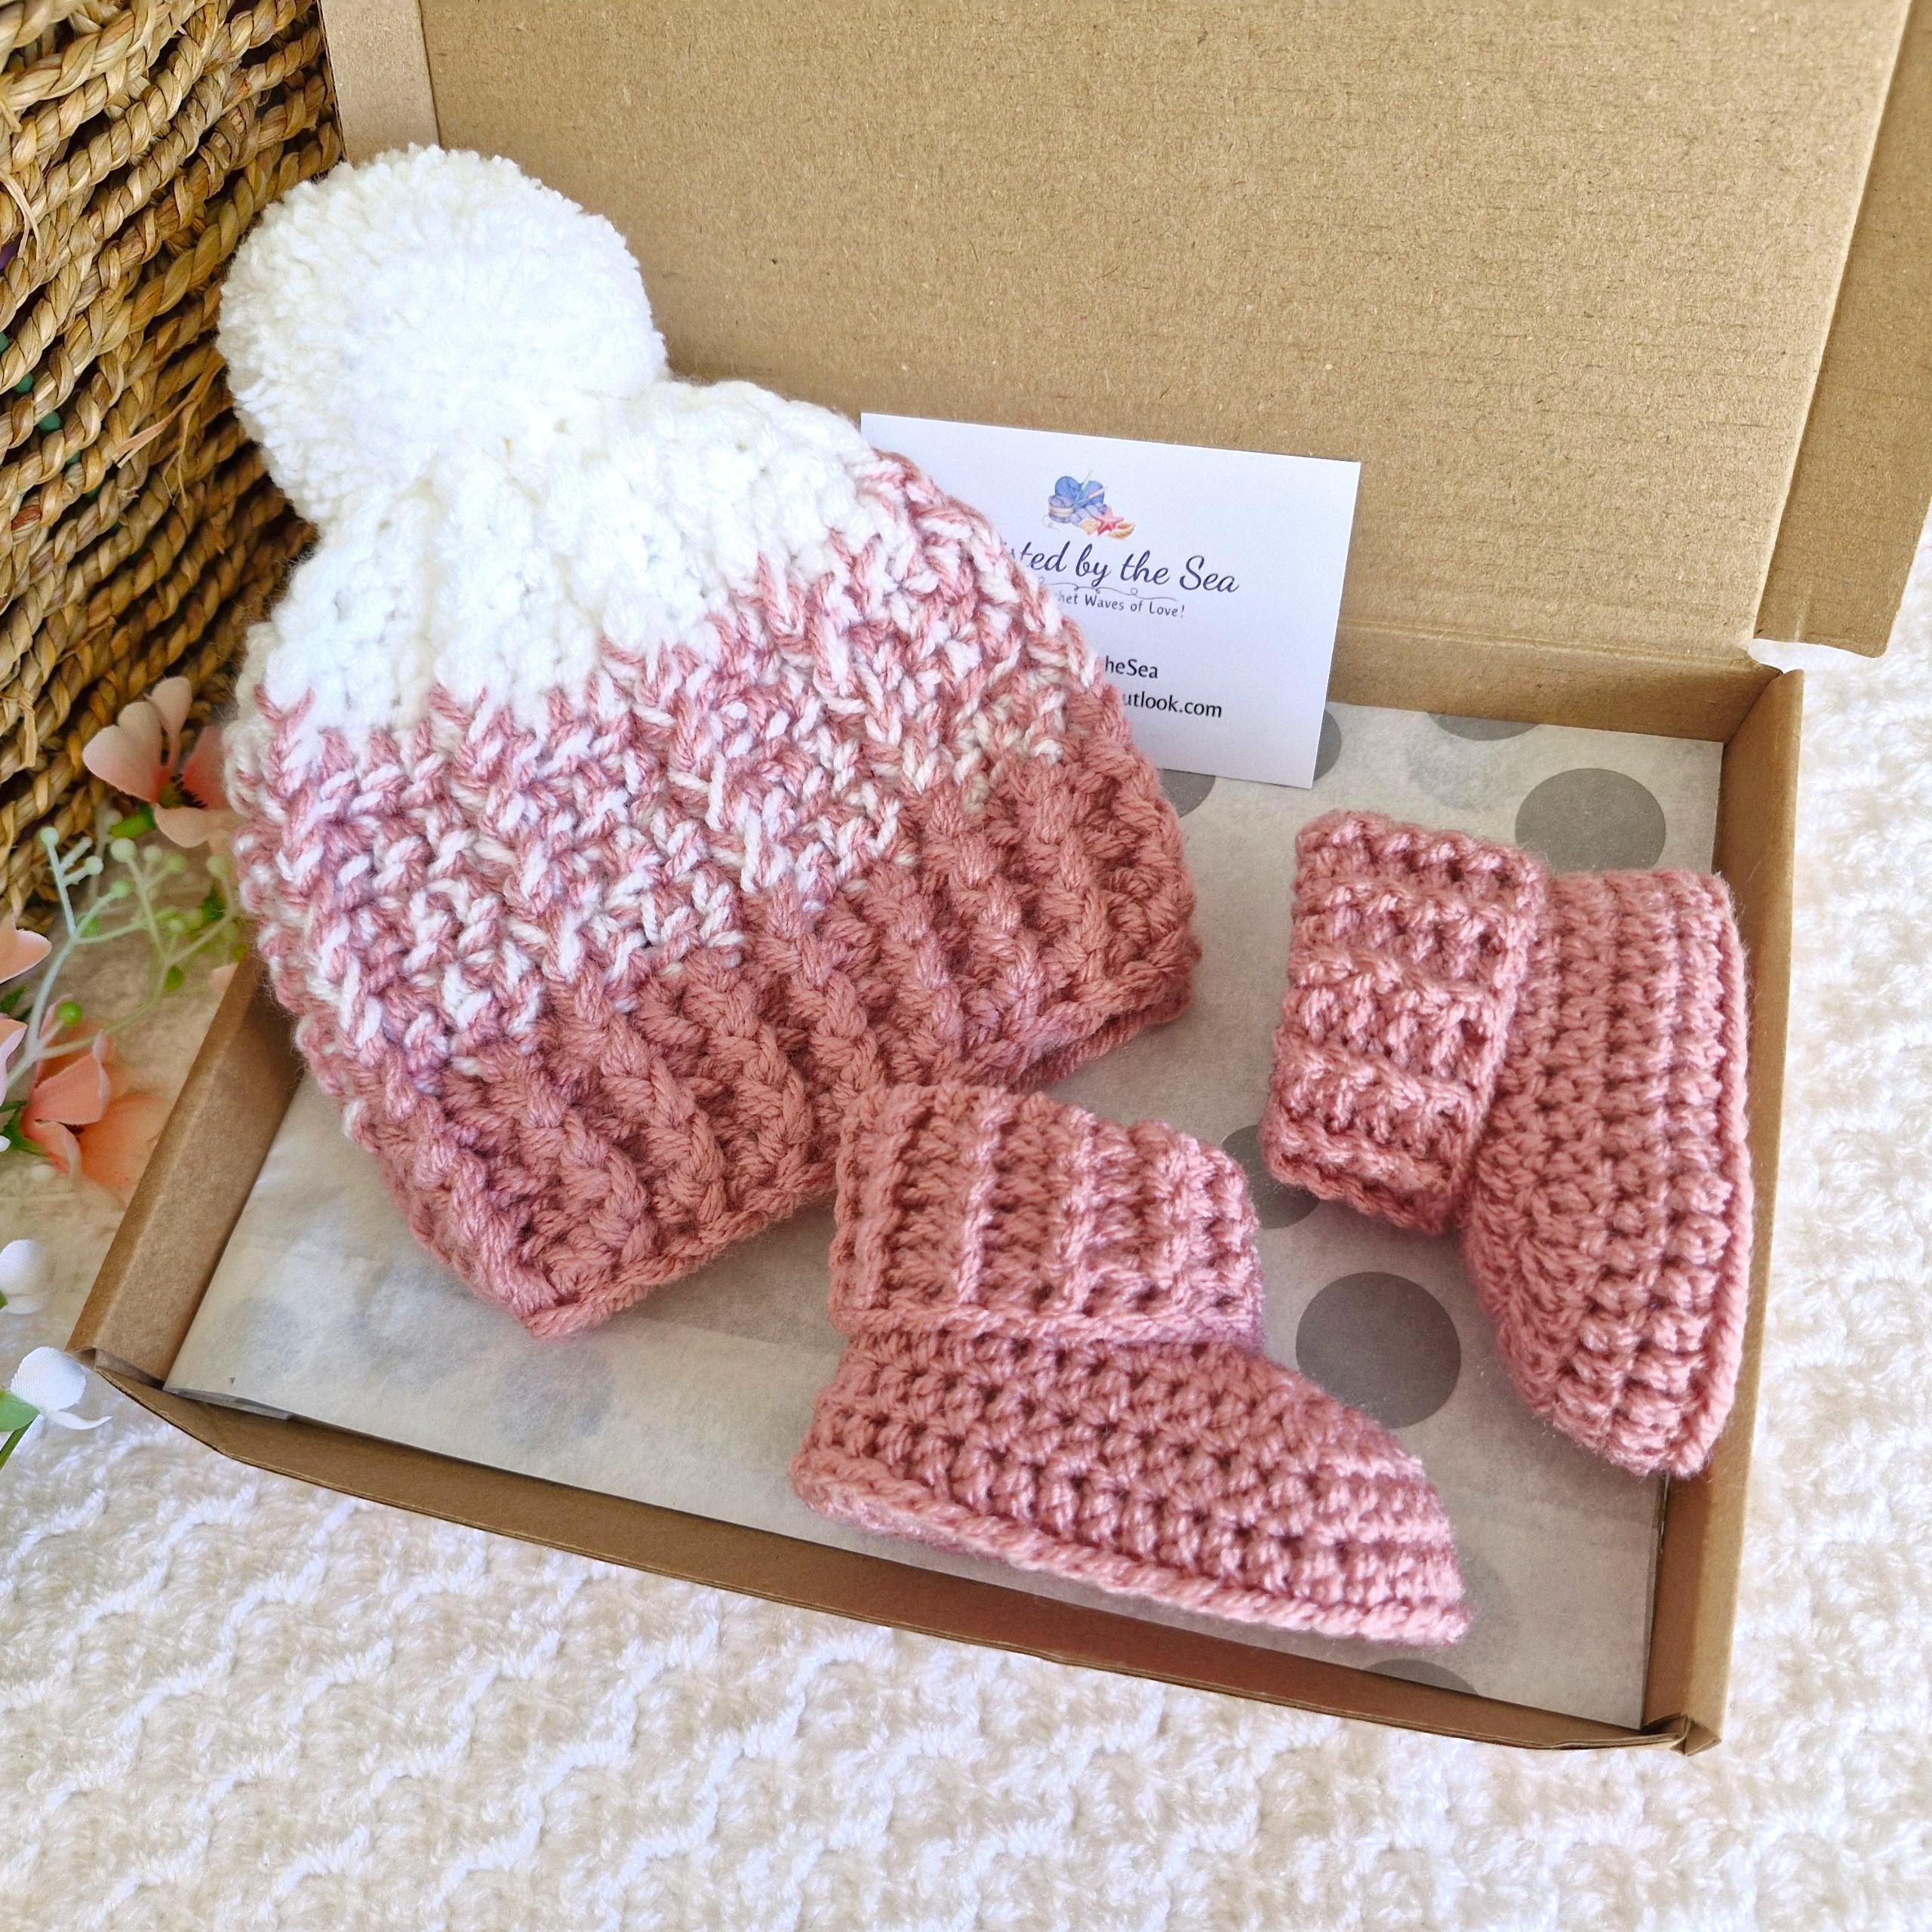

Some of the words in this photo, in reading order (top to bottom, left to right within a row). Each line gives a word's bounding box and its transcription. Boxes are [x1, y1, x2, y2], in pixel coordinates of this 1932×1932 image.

[1004, 540, 1071, 573] ted
[1075, 543, 1112, 587] by
[1120, 550, 1171, 585] the
[1180, 555, 1239, 593] Sea
[1057, 591, 1078, 605] het
[1084, 593, 1124, 611] Waves
[1130, 600, 1143, 613] of
[1149, 601, 1185, 618] Love!
[1105, 655, 1158, 678] heSea
[1122, 691, 1223, 718] utlook.com
